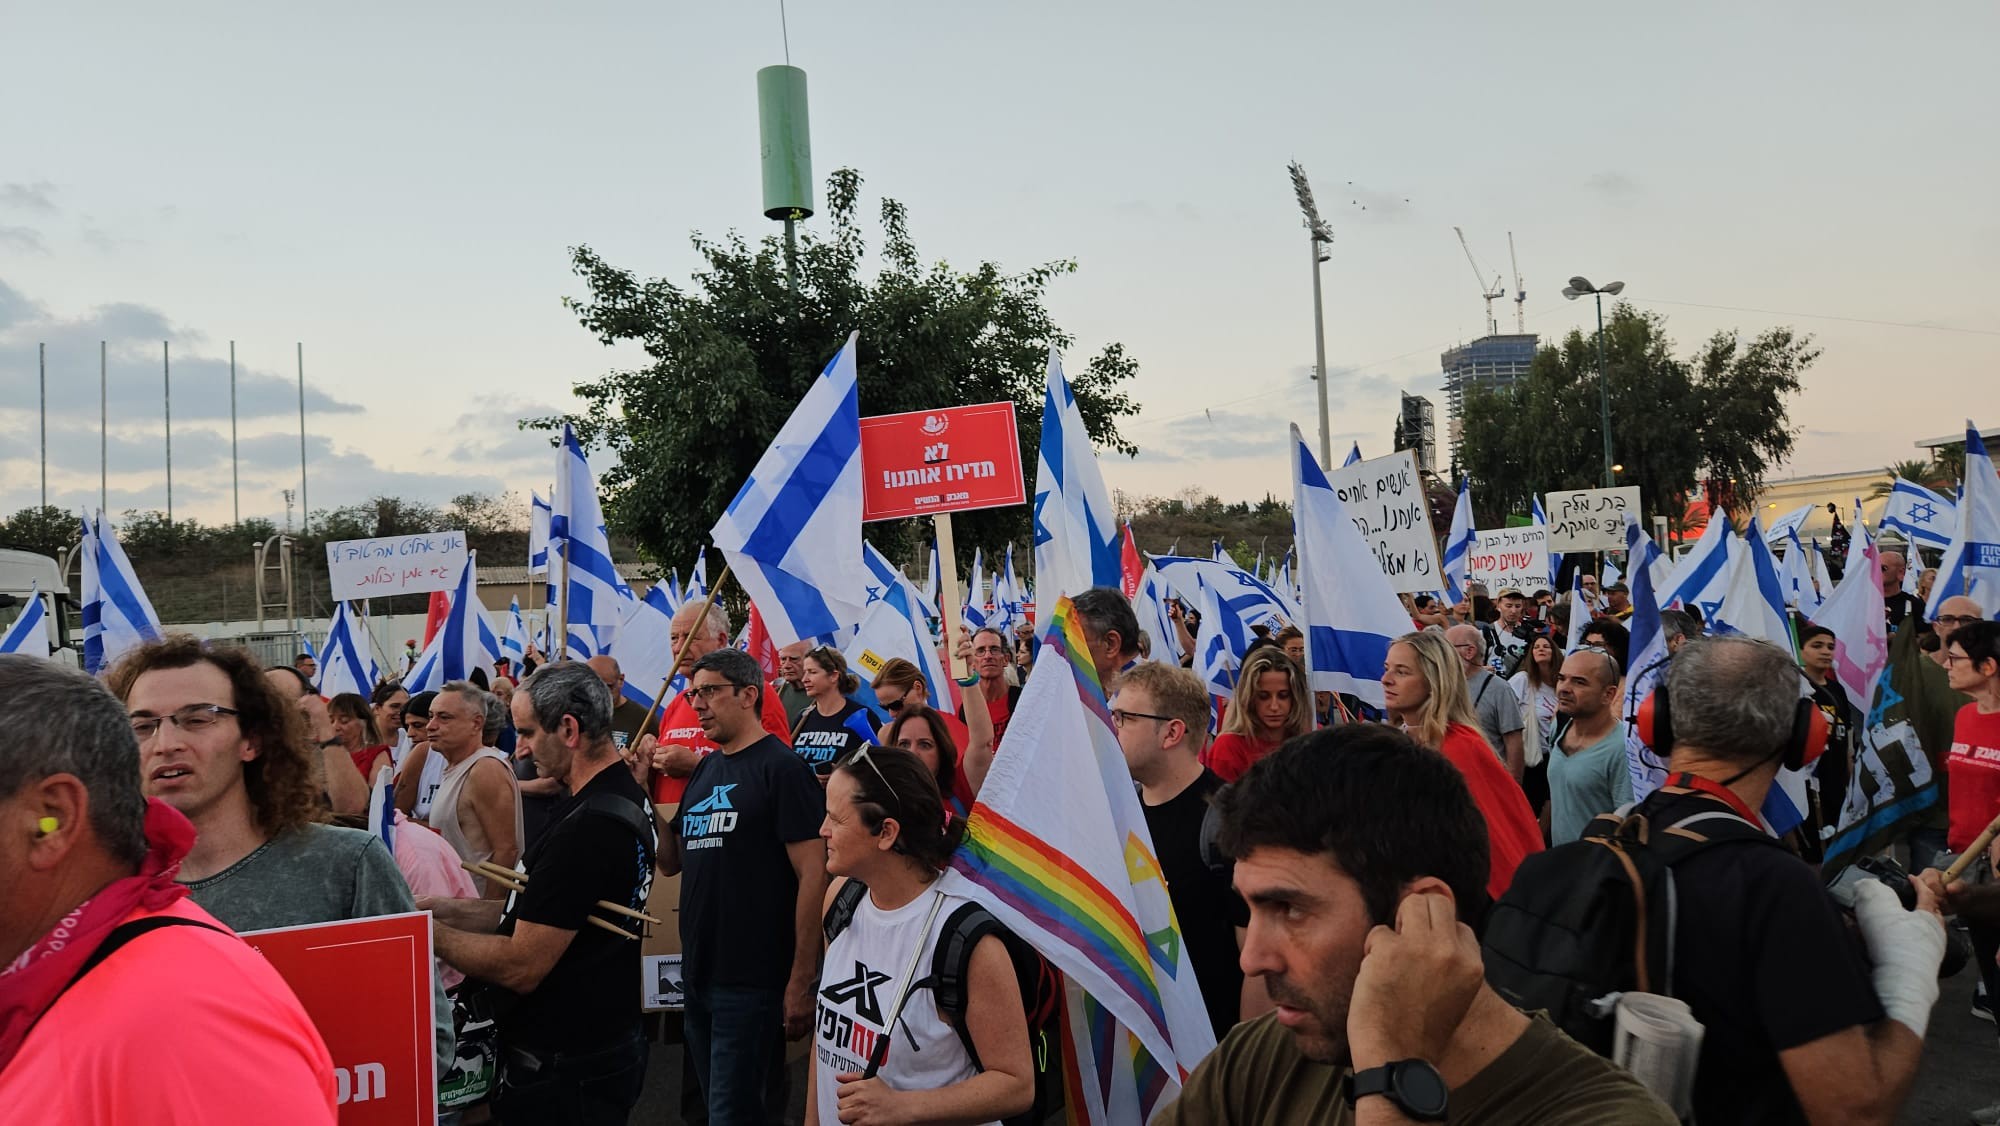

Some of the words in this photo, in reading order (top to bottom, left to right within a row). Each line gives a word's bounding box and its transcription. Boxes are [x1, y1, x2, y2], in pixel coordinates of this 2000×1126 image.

[924, 442, 949, 462] לא
[883, 466, 941, 489] אותנו!
[946, 460, 996, 481] תדירו
[1337, 478, 1368, 503] אחים
[400, 537, 434, 556] אחליט
[441, 537, 462, 554] אני
[1485, 536, 1501, 551] הבן
[1503, 532, 1518, 547] של
[332, 542, 351, 563] לי
[346, 541, 376, 561] טוב
[374, 543, 395, 558] מה
[1499, 551, 1533, 571] שווים
[356, 566, 395, 586] יכולות
[402, 567, 423, 588] אתן
[430, 566, 449, 579] גם
[794, 731, 849, 747] נאמנים
